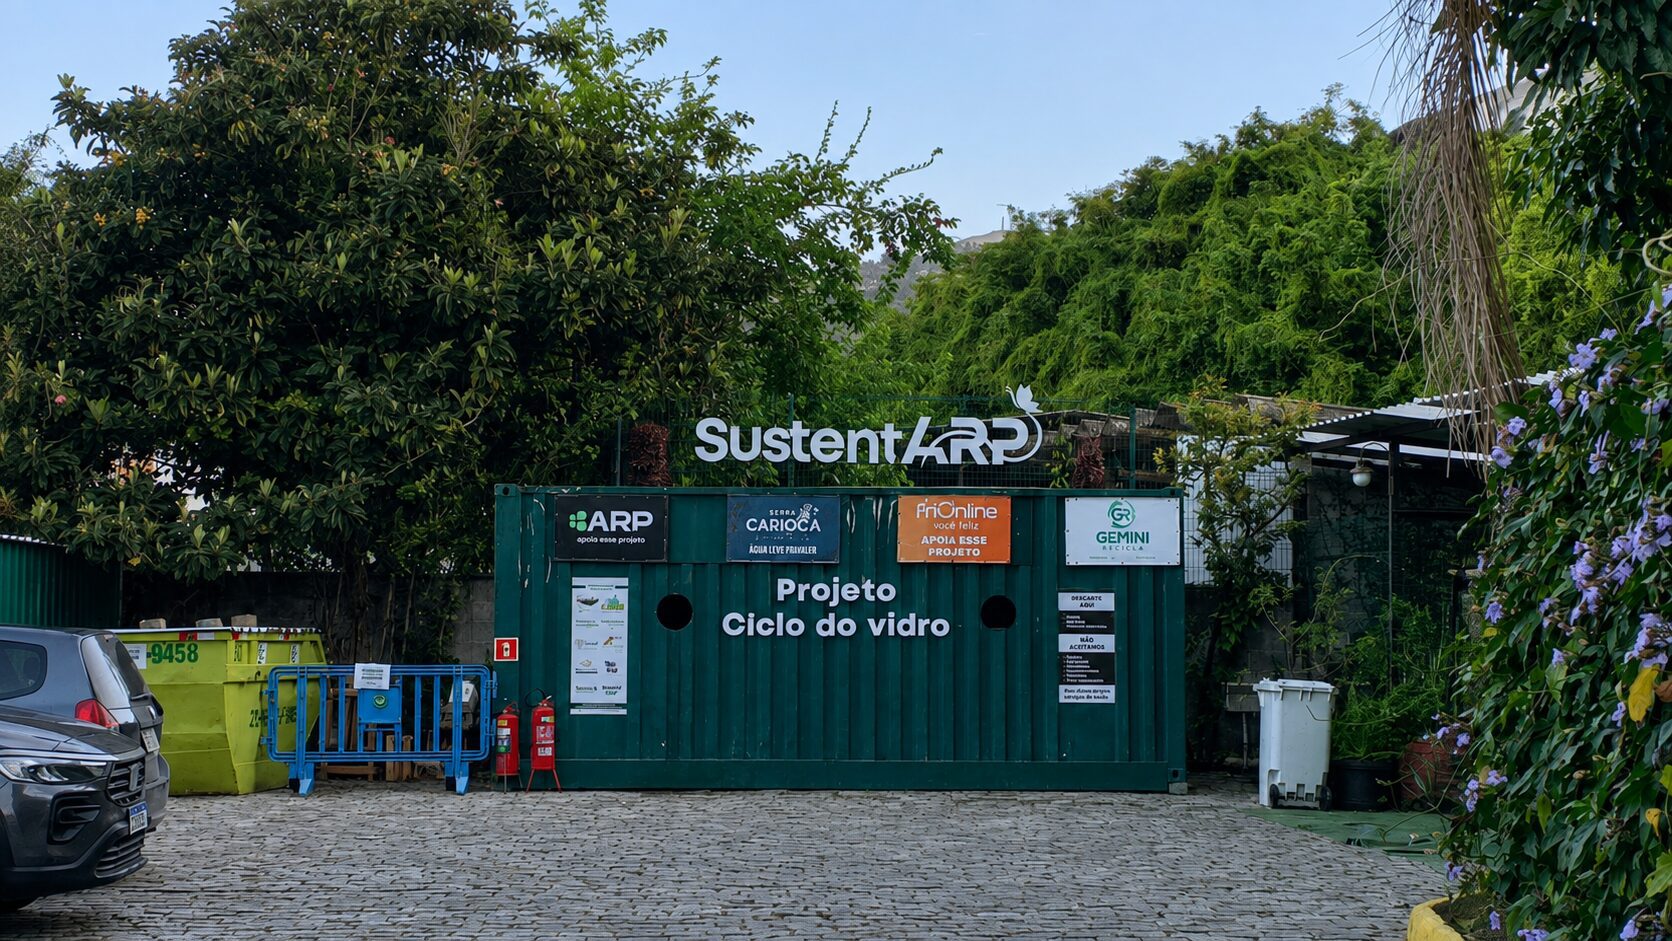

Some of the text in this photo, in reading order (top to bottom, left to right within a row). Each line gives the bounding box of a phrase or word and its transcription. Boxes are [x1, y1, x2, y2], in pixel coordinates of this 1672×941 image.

[695, 416, 1036, 467] SustentARP
[587, 511, 654, 532] ARP
[746, 518, 821, 532] CARIOCA
[618, 536, 646, 544] projeto
[921, 536, 988, 545] APOIA ESSE
[1096, 531, 1150, 544] GEMINI
[928, 548, 981, 556] PROJETO
[777, 577, 897, 607] Projeto
[722, 612, 950, 637] Ciclo do vidro
